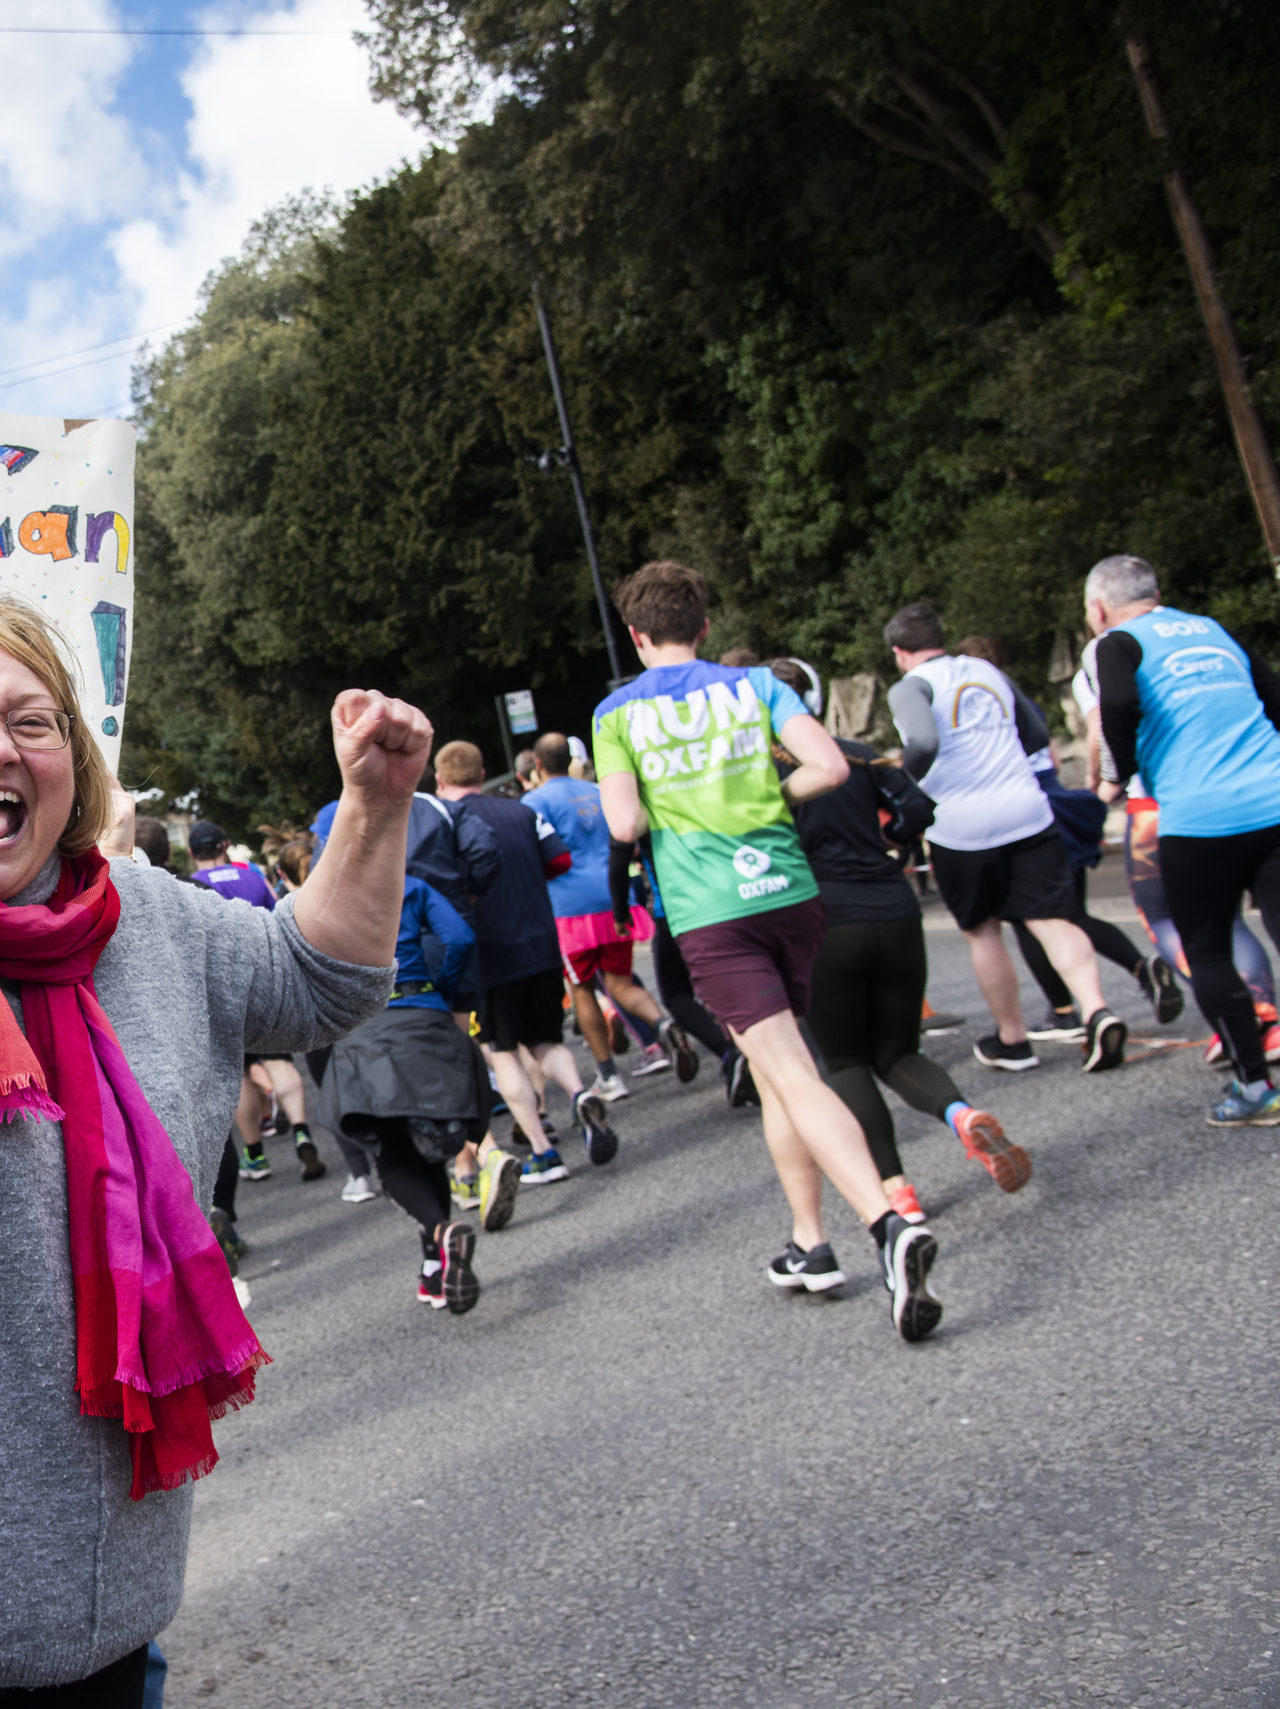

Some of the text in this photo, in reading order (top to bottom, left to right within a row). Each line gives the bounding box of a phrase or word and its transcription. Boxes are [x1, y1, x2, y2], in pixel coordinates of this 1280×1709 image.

[1151, 620, 1209, 638] BOB
[625, 678, 762, 751] RUN
[641, 727, 767, 781] OXFAM
[738, 874, 789, 900] OXFAM
